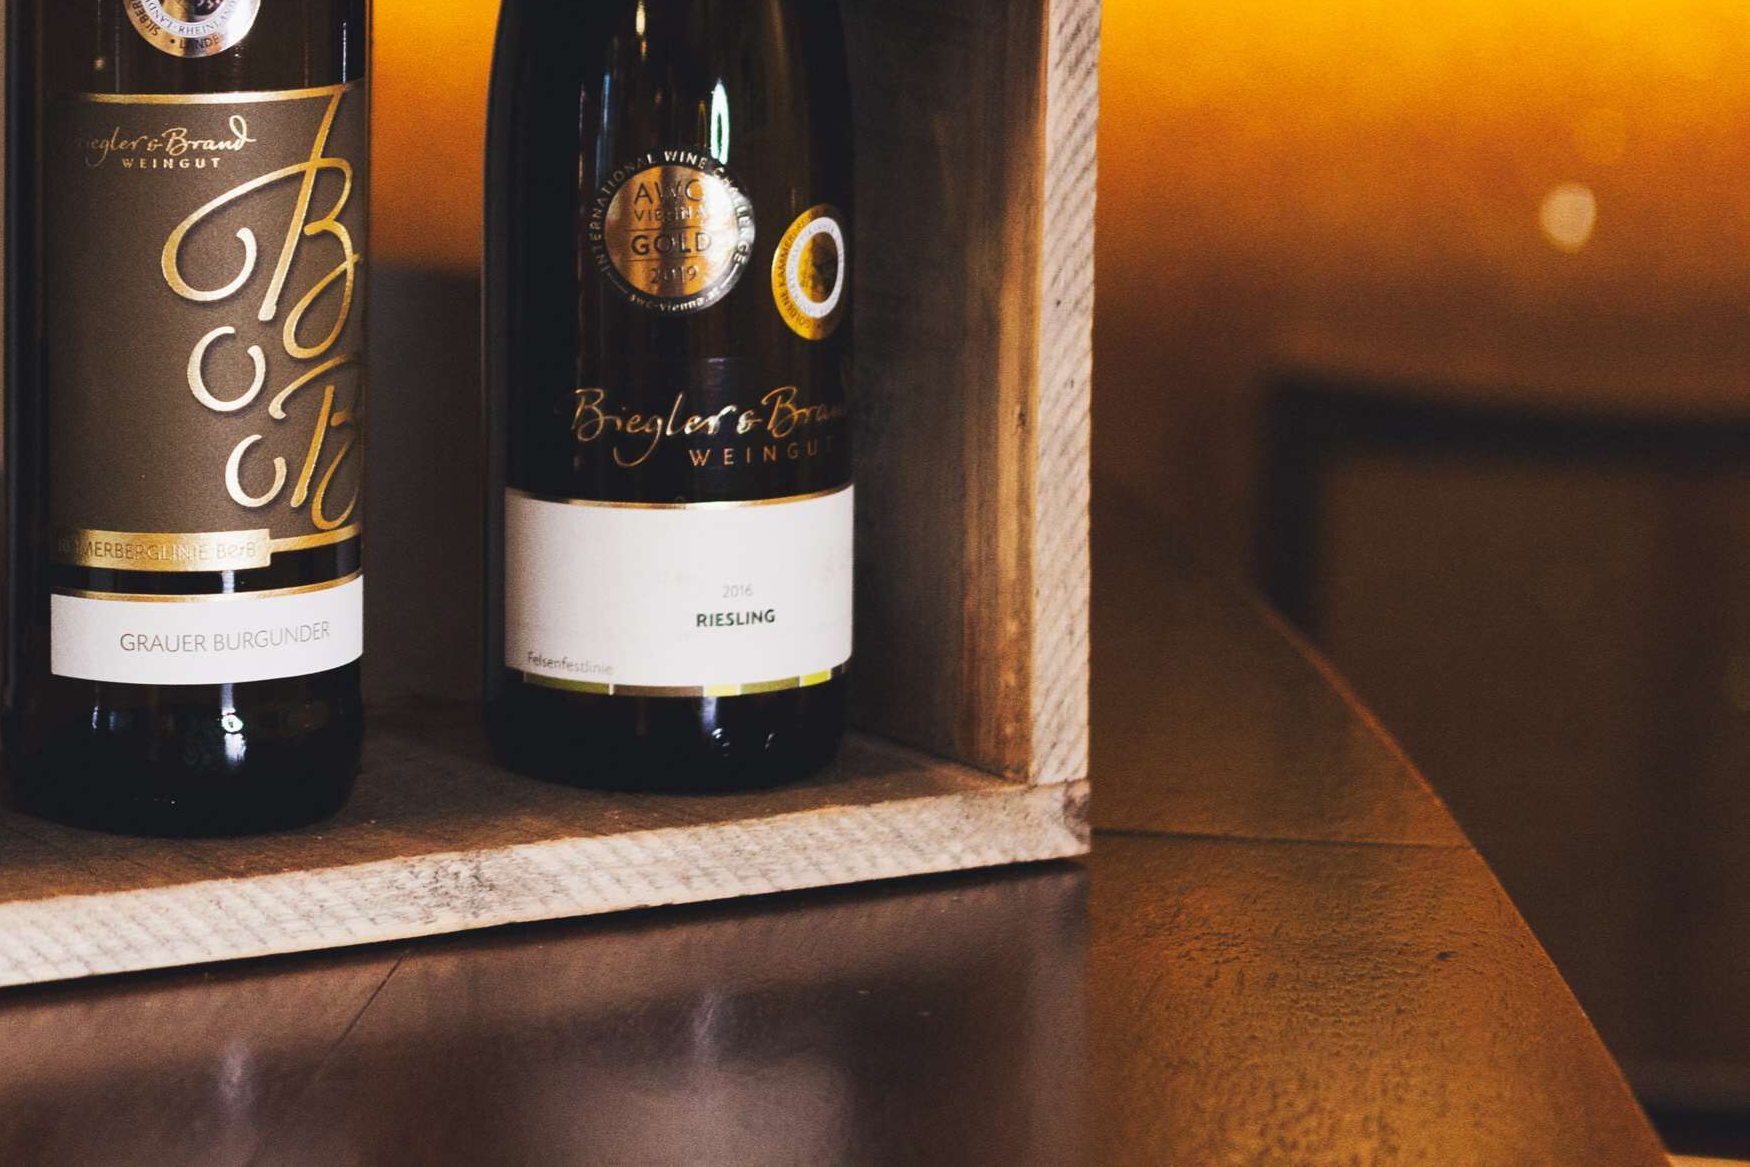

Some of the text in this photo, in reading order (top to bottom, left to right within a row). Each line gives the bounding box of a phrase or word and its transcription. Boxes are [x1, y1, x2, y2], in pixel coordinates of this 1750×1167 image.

[161, 114, 258, 157] Brand
[121, 156, 222, 170] WEINGUT
[588, 153, 657, 274] INTERNATIONAL
[663, 149, 709, 170] WINE
[713, 166, 751, 265] CHALLENGE
[631, 231, 713, 256] GOLD
[649, 265, 699, 284] 2019
[570, 388, 738, 468] Biegler
[688, 436, 835, 468] WEINGUT
[696, 608, 776, 627] RIESLING
[119, 620, 331, 654] GRAUER BURGUNDER
